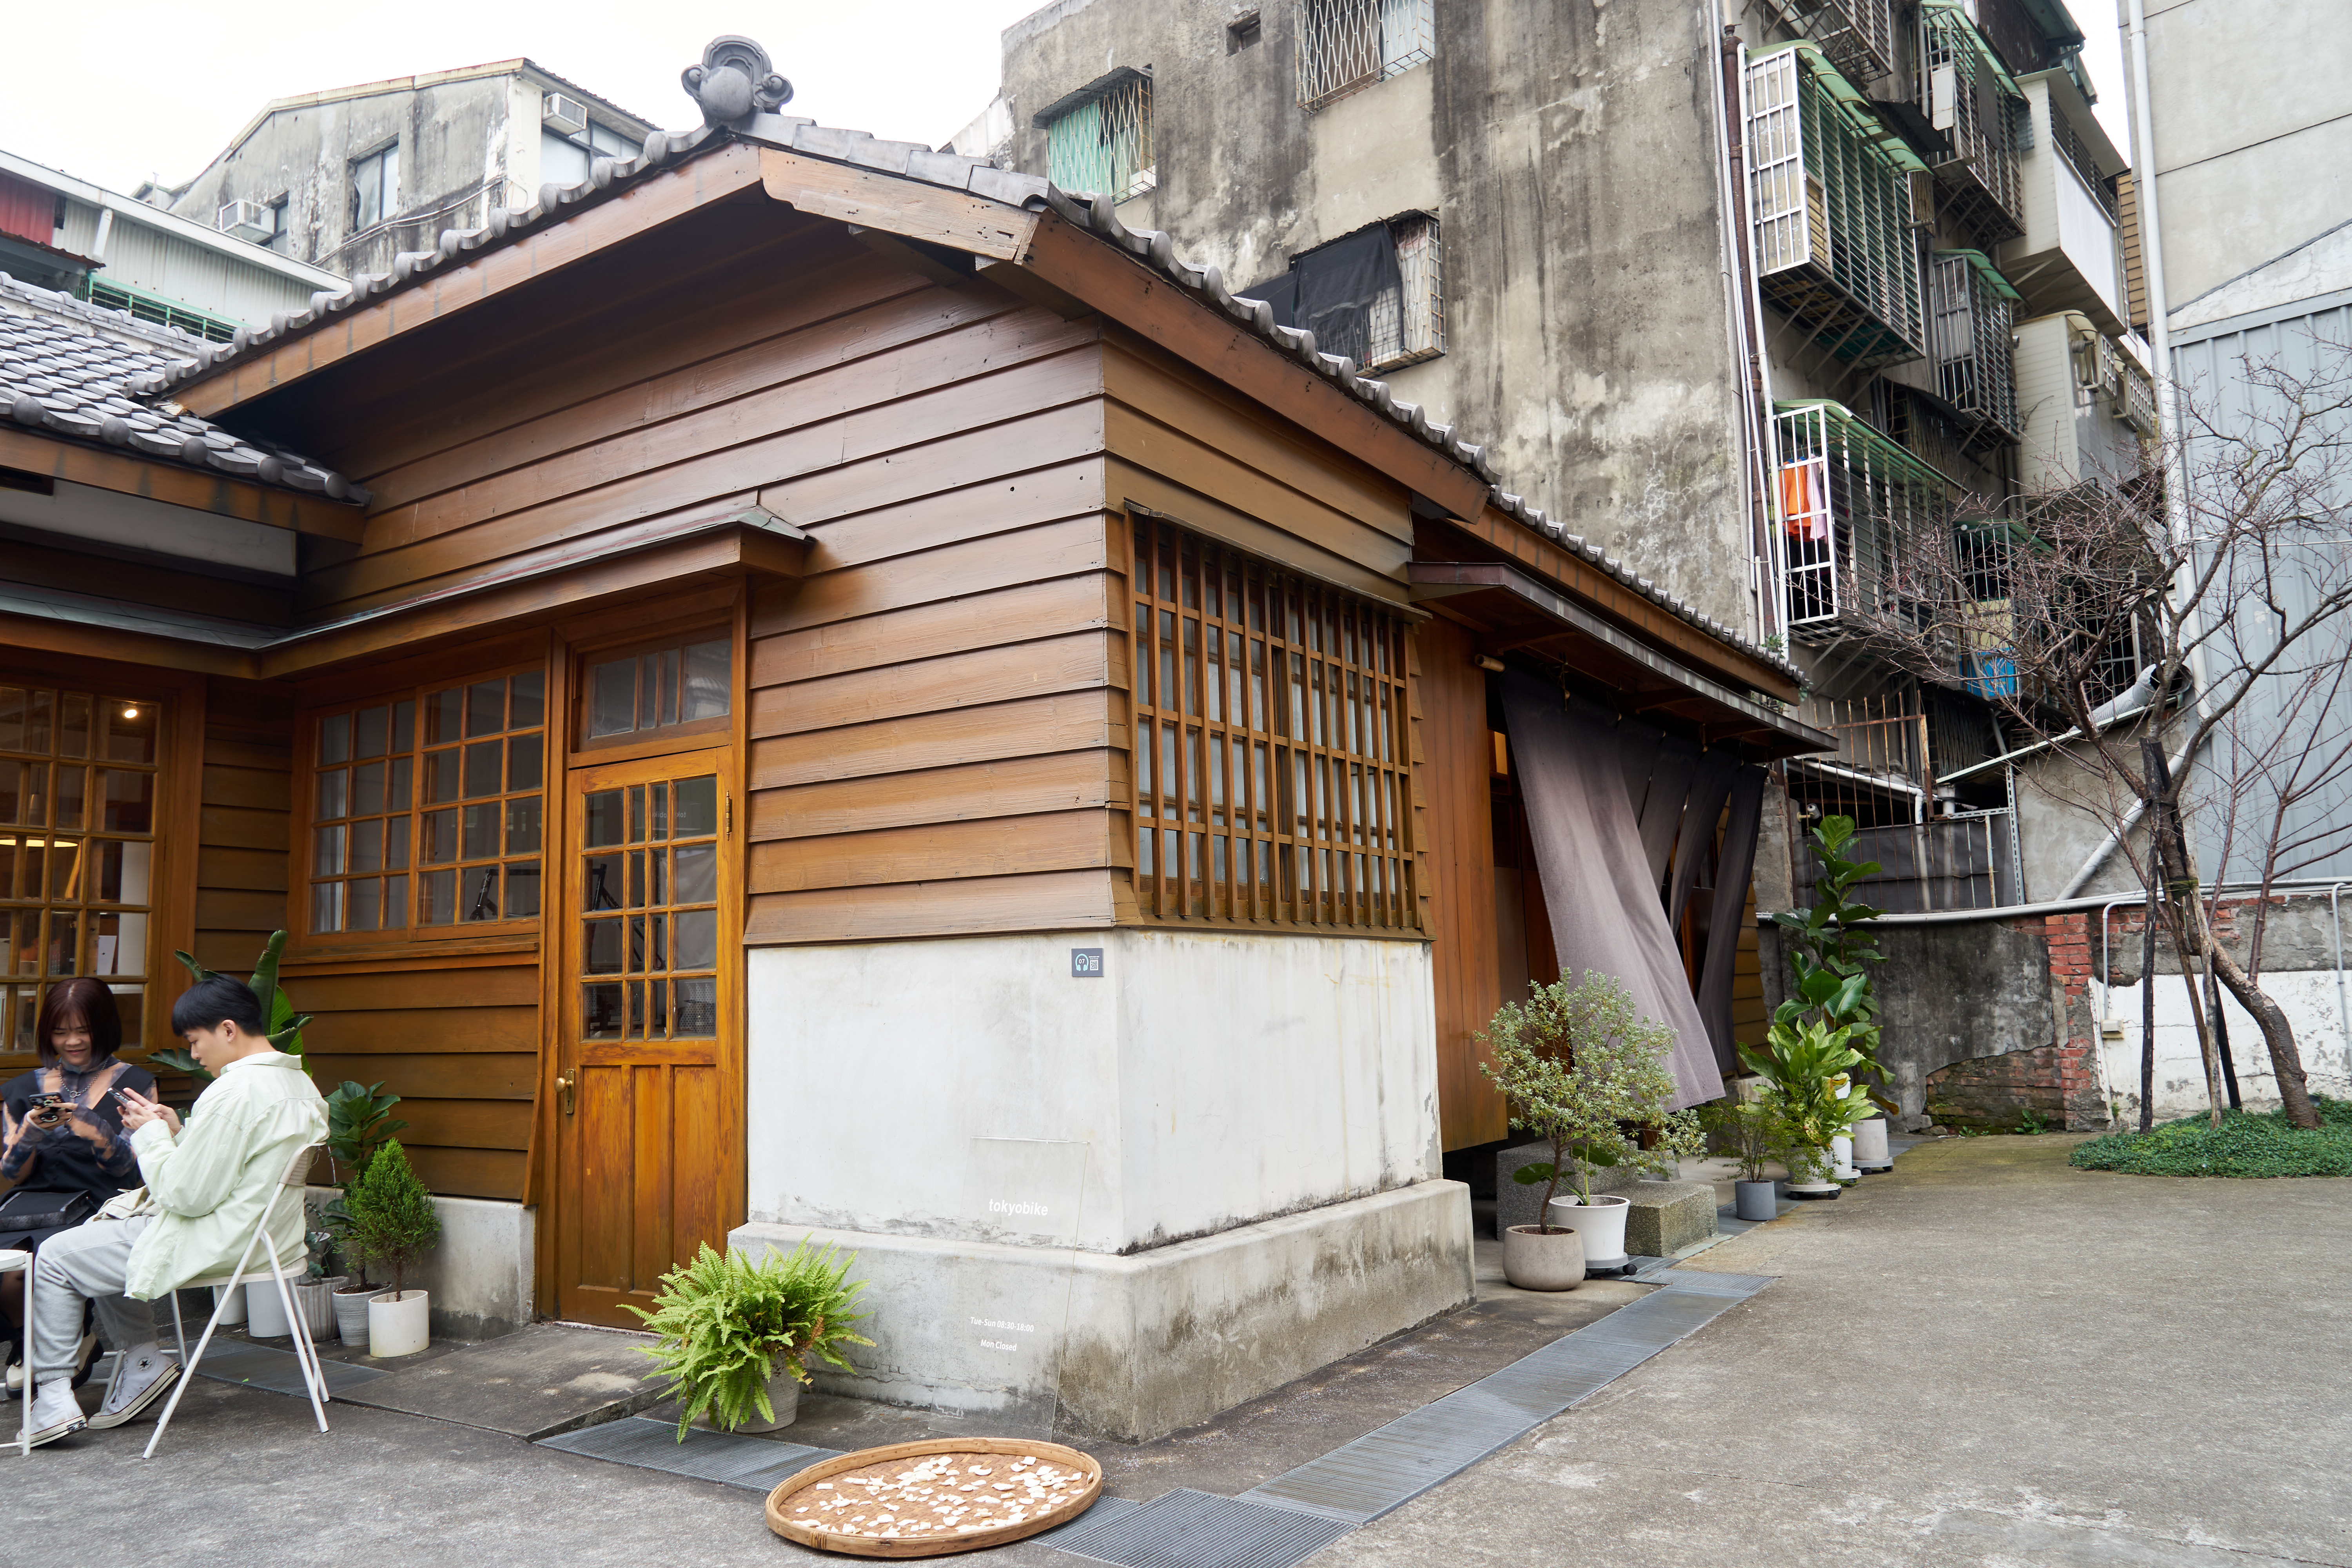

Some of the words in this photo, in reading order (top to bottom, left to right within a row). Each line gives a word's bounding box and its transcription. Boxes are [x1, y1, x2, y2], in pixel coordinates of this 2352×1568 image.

[989, 1199, 1048, 1216] tokyobike
[971, 1317, 996, 1327] Tue-Sun
[997, 1320, 1034, 1332] 08:30-18:00
[981, 1339, 995, 1348] Mon
[995, 1341, 1017, 1351] Closed
